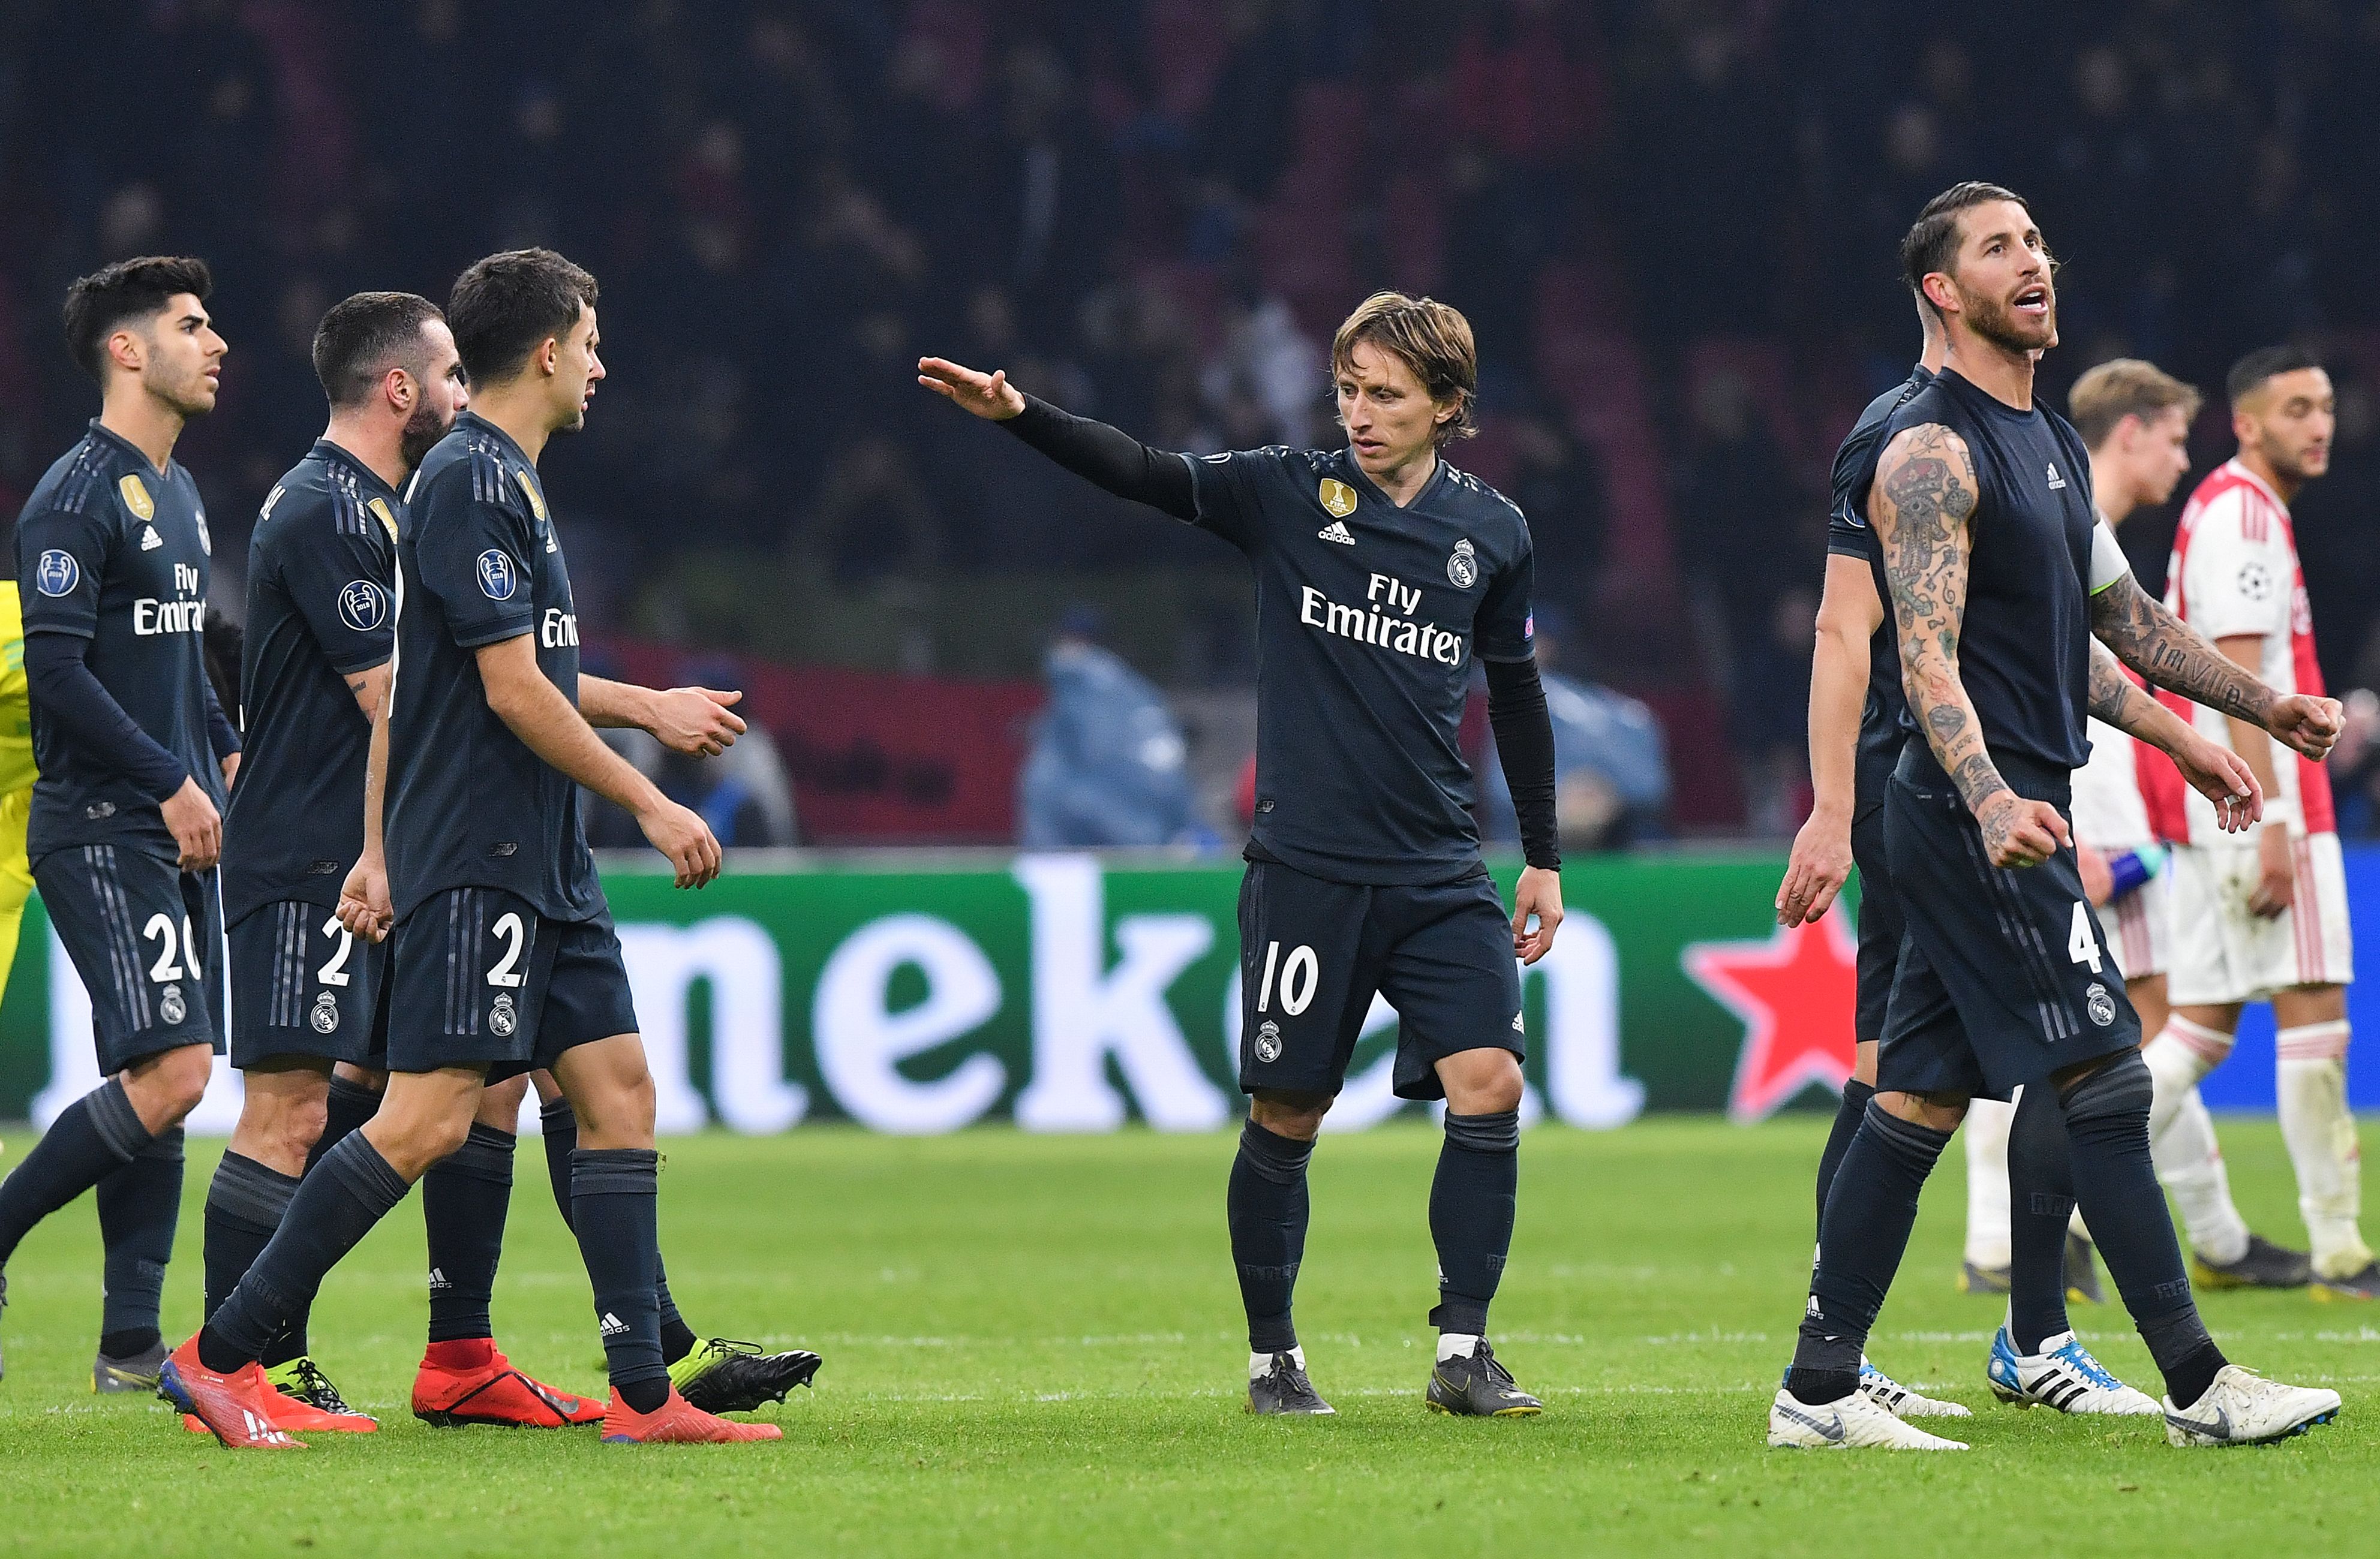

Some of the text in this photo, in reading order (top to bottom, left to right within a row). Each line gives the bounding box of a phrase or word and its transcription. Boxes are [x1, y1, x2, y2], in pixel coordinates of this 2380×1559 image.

[1318, 529, 1356, 546] adidas
[174, 563, 198, 596] Fly
[356, 601, 371, 612] 2018
[1368, 573, 1422, 616] Fly
[1300, 585, 1462, 666] Emirates
[143, 913, 202, 983] 20
[2068, 900, 2103, 974] 4
[1257, 941, 1319, 1016] 10
